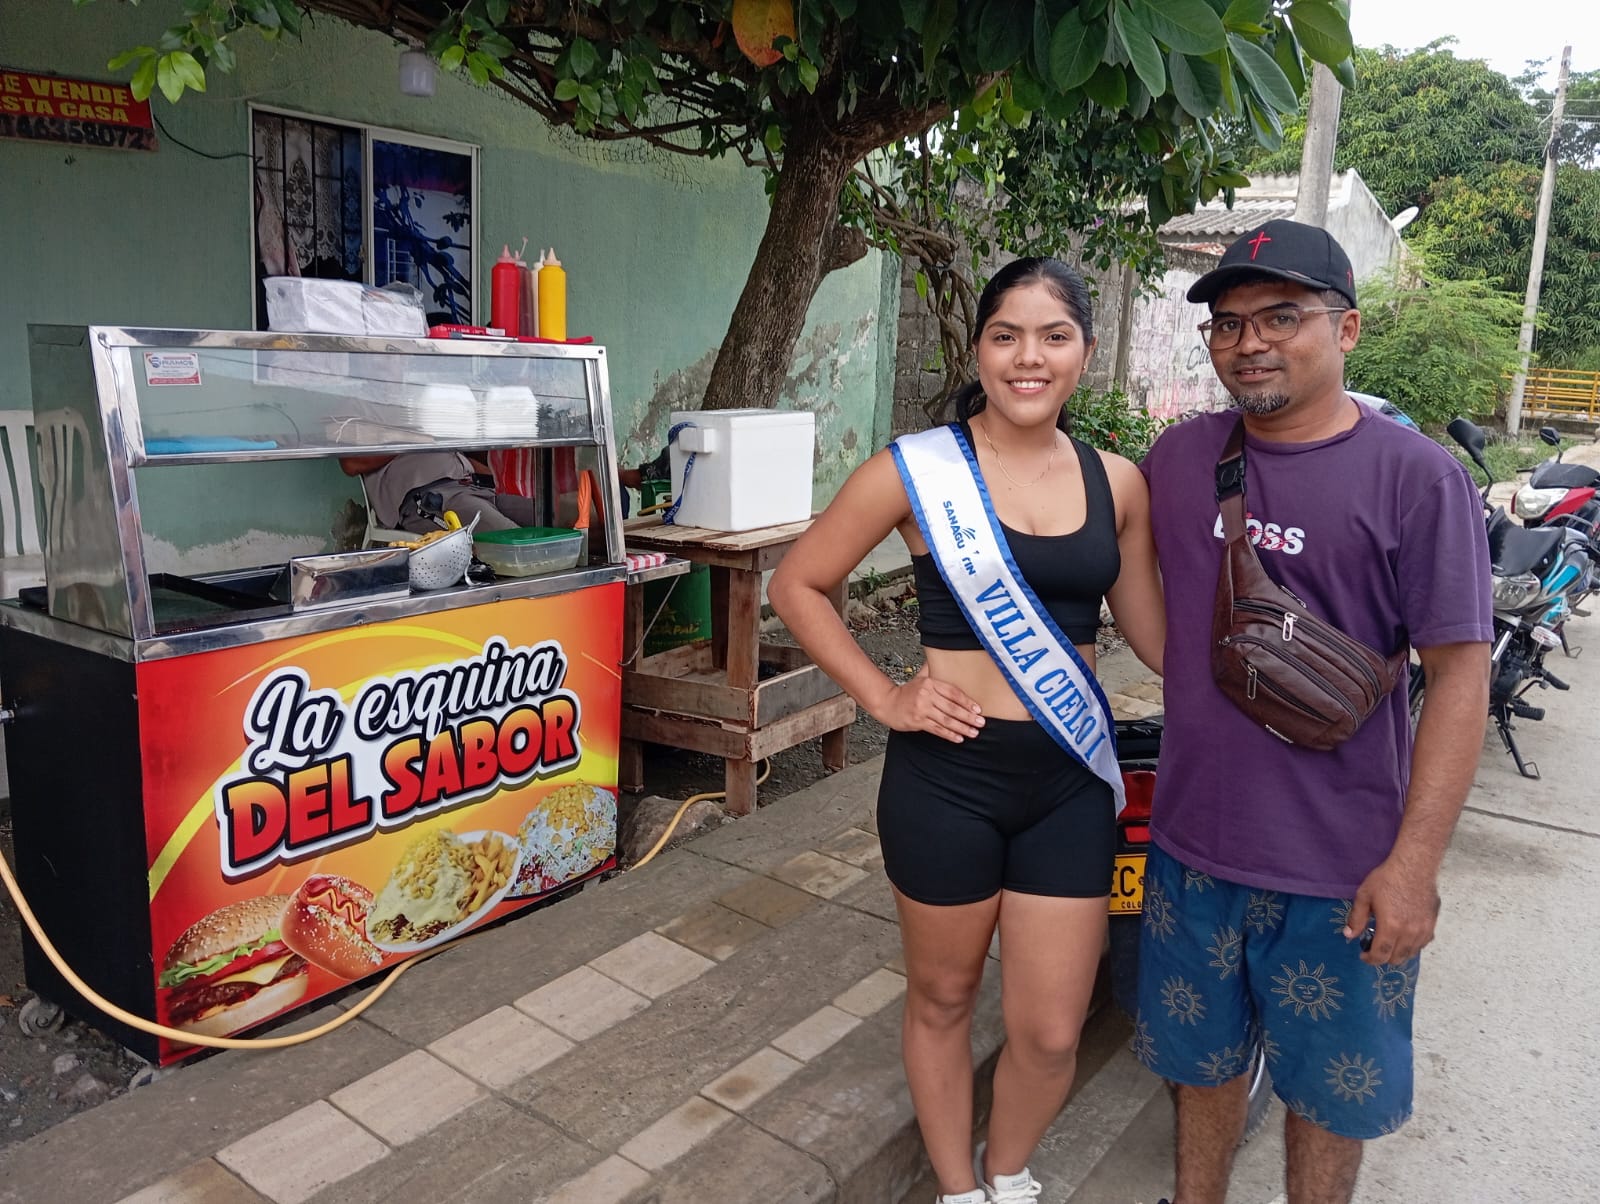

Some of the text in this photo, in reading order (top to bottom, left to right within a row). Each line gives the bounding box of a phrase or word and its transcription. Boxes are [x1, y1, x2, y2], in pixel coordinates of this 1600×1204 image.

[0, 73, 130, 107] E VENDE
[0, 95, 130, 123] STA CASA
[253, 641, 563, 770] La esquina
[975, 578, 1050, 674] VILLA
[1034, 668, 1100, 746] CIELO
[226, 699, 575, 863] DEL SABOR
